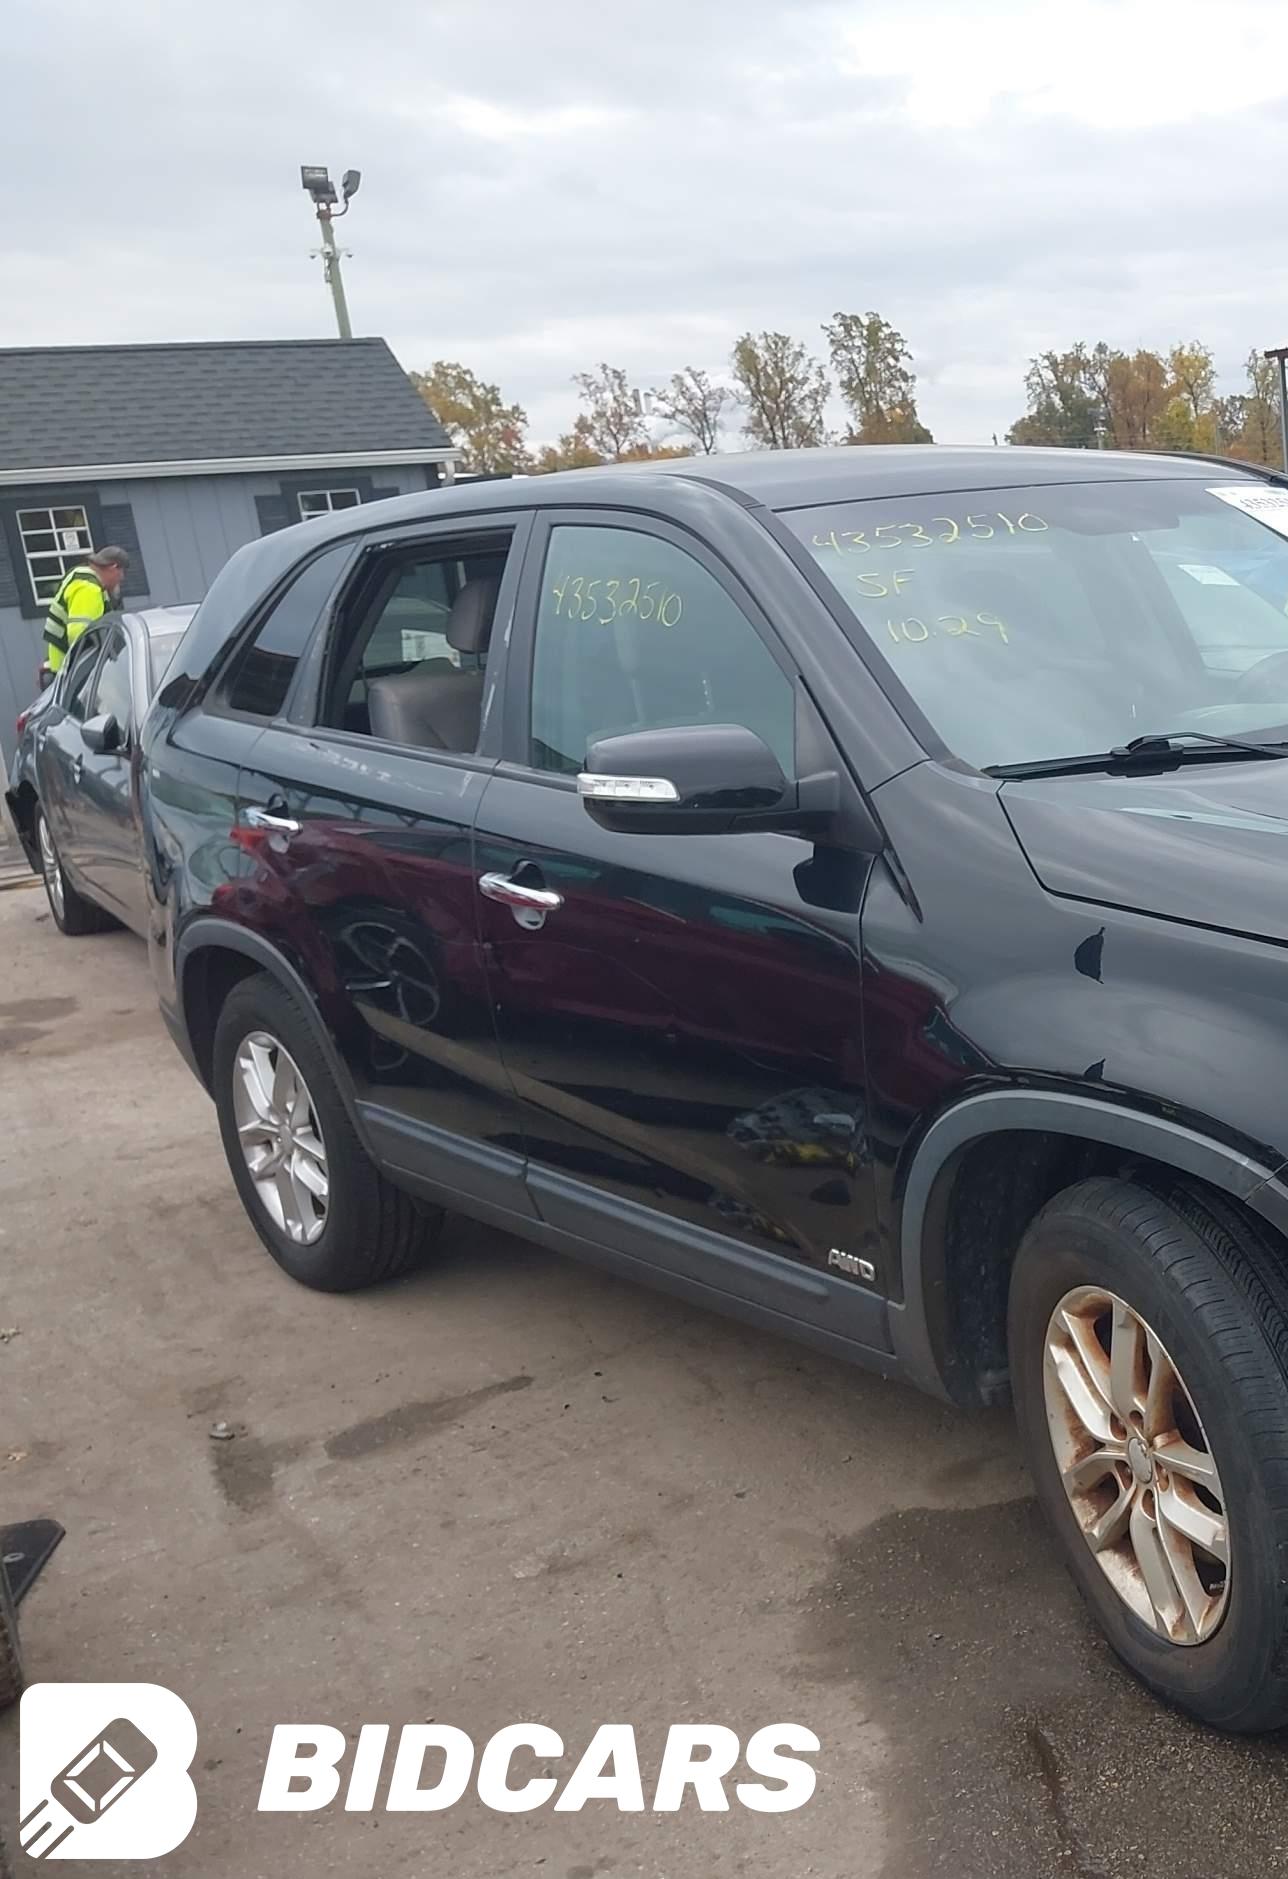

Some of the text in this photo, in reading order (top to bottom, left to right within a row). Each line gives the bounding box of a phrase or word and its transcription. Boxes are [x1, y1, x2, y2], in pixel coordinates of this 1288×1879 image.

[812, 512, 1049, 556] 43532510
[552, 575, 682, 627] 43532510
[856, 568, 916, 598] SF
